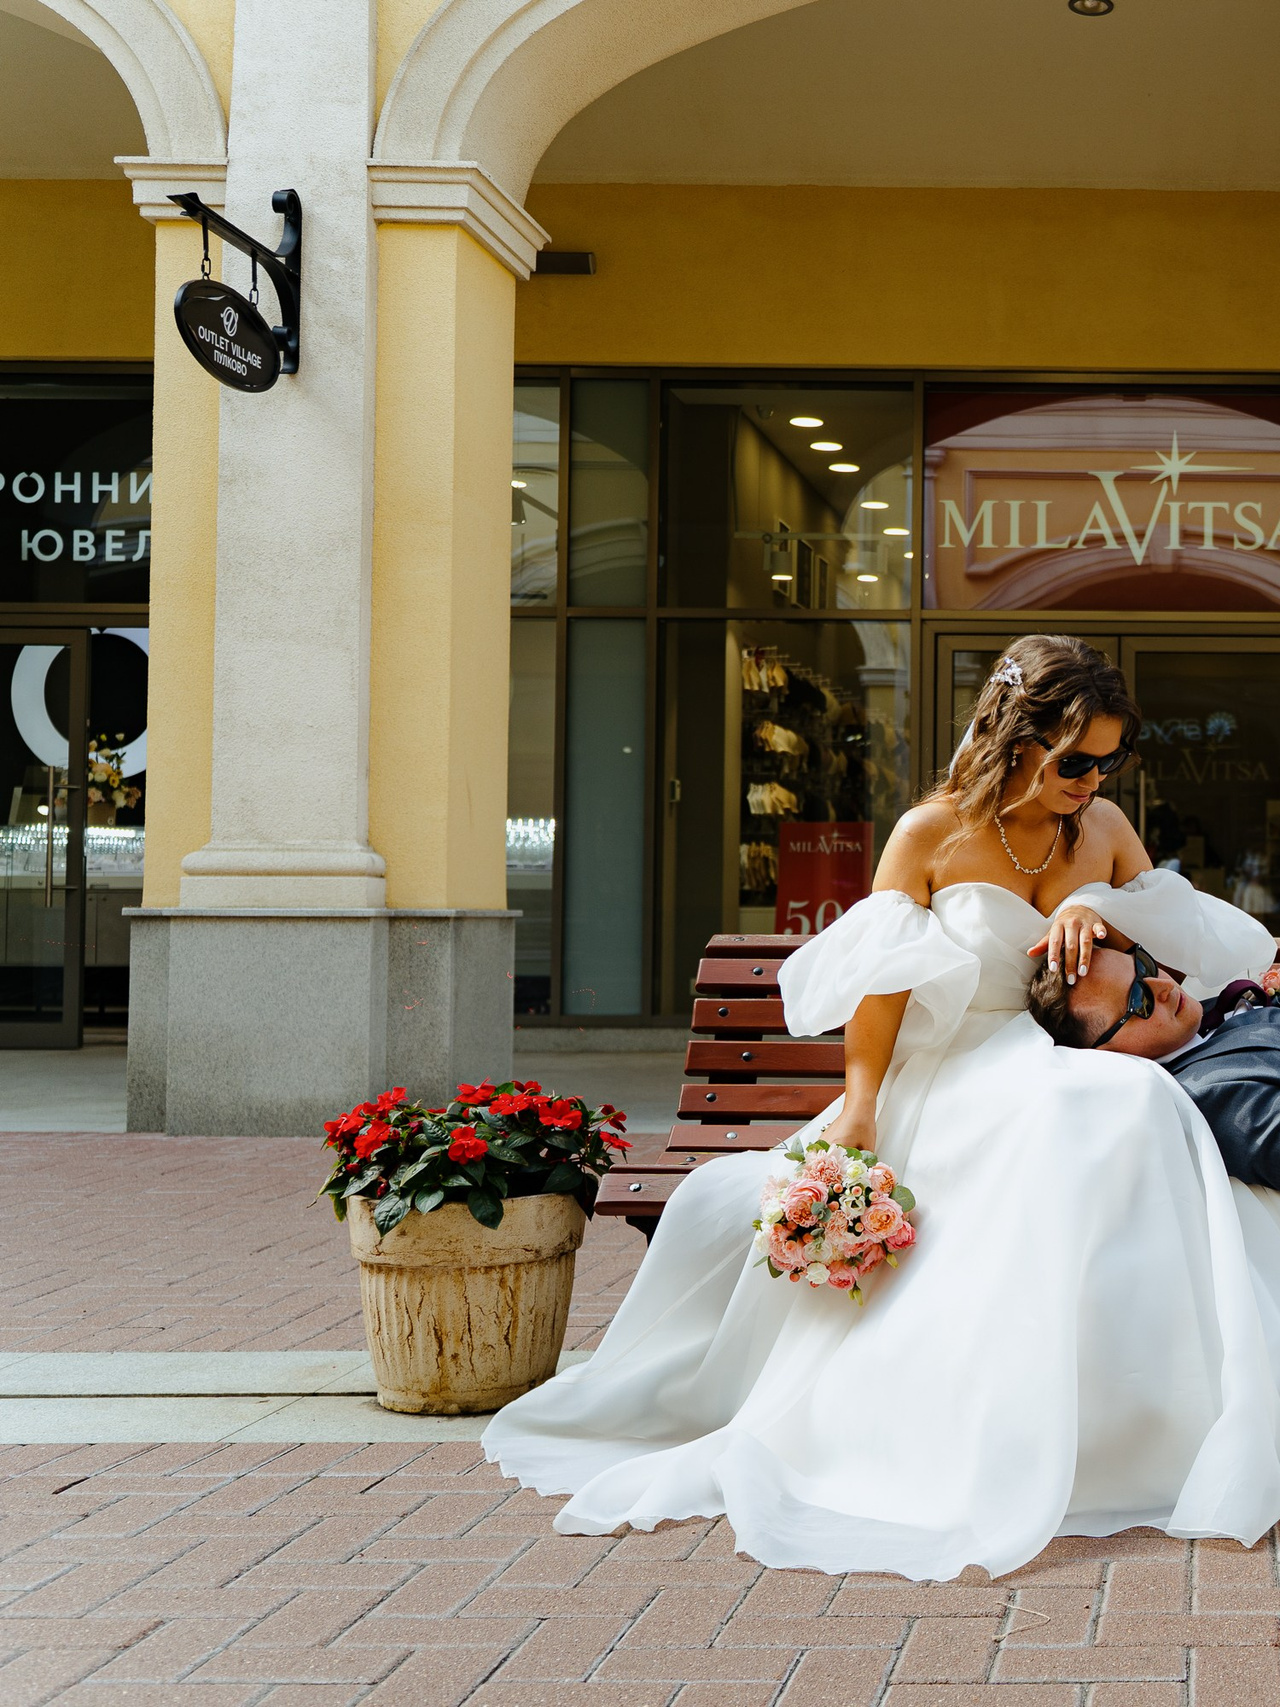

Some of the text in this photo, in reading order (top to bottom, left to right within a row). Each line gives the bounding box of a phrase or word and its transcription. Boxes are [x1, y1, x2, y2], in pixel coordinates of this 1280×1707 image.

[198, 325, 262, 369] OUTLET VILLAGE
[213, 349, 248, 376] ПУЛКОВО
[1145, 747, 1271, 785] ILAVITSA
[788, 835, 863, 855] MILAVITSA
